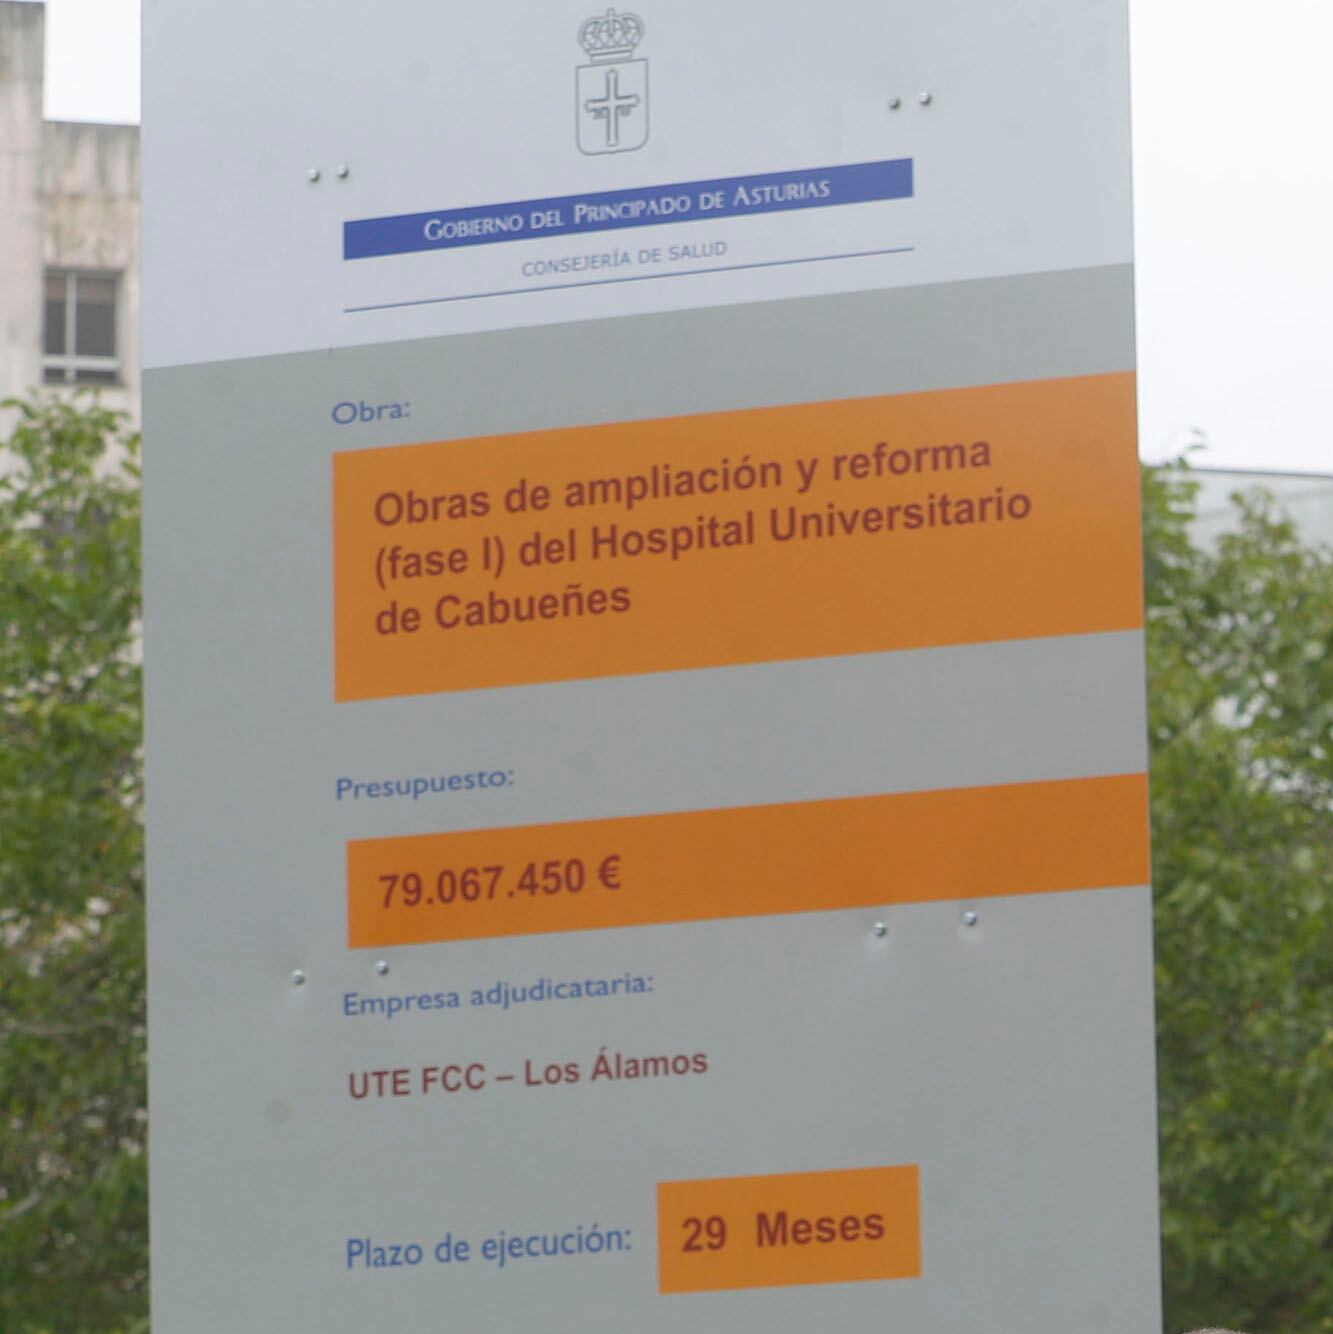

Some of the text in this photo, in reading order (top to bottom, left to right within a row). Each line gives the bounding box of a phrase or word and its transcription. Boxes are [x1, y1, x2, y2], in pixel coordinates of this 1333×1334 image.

[521, 240, 728, 277] CONSEJERÍA DE SALUD
[331, 400, 410, 425] Obra:
[374, 441, 991, 527] Obras de ampliación y reforma
[375, 487, 1032, 590] (fase I) del Hospital Universitario
[375, 583, 631, 636] de Cabueñes
[335, 769, 514, 801] Presupuesto:
[378, 854, 621, 909] 79.067.450 €
[343, 973, 653, 1020] Empresa adjudicataria:
[349, 1068, 411, 1100] UTE
[422, 1063, 486, 1094] FCC
[524, 1059, 581, 1087] Los
[591, 1046, 709, 1082] Álamos
[346, 1223, 631, 1269] Plazo de ejecución:
[682, 1210, 885, 1253] 29 Meses
